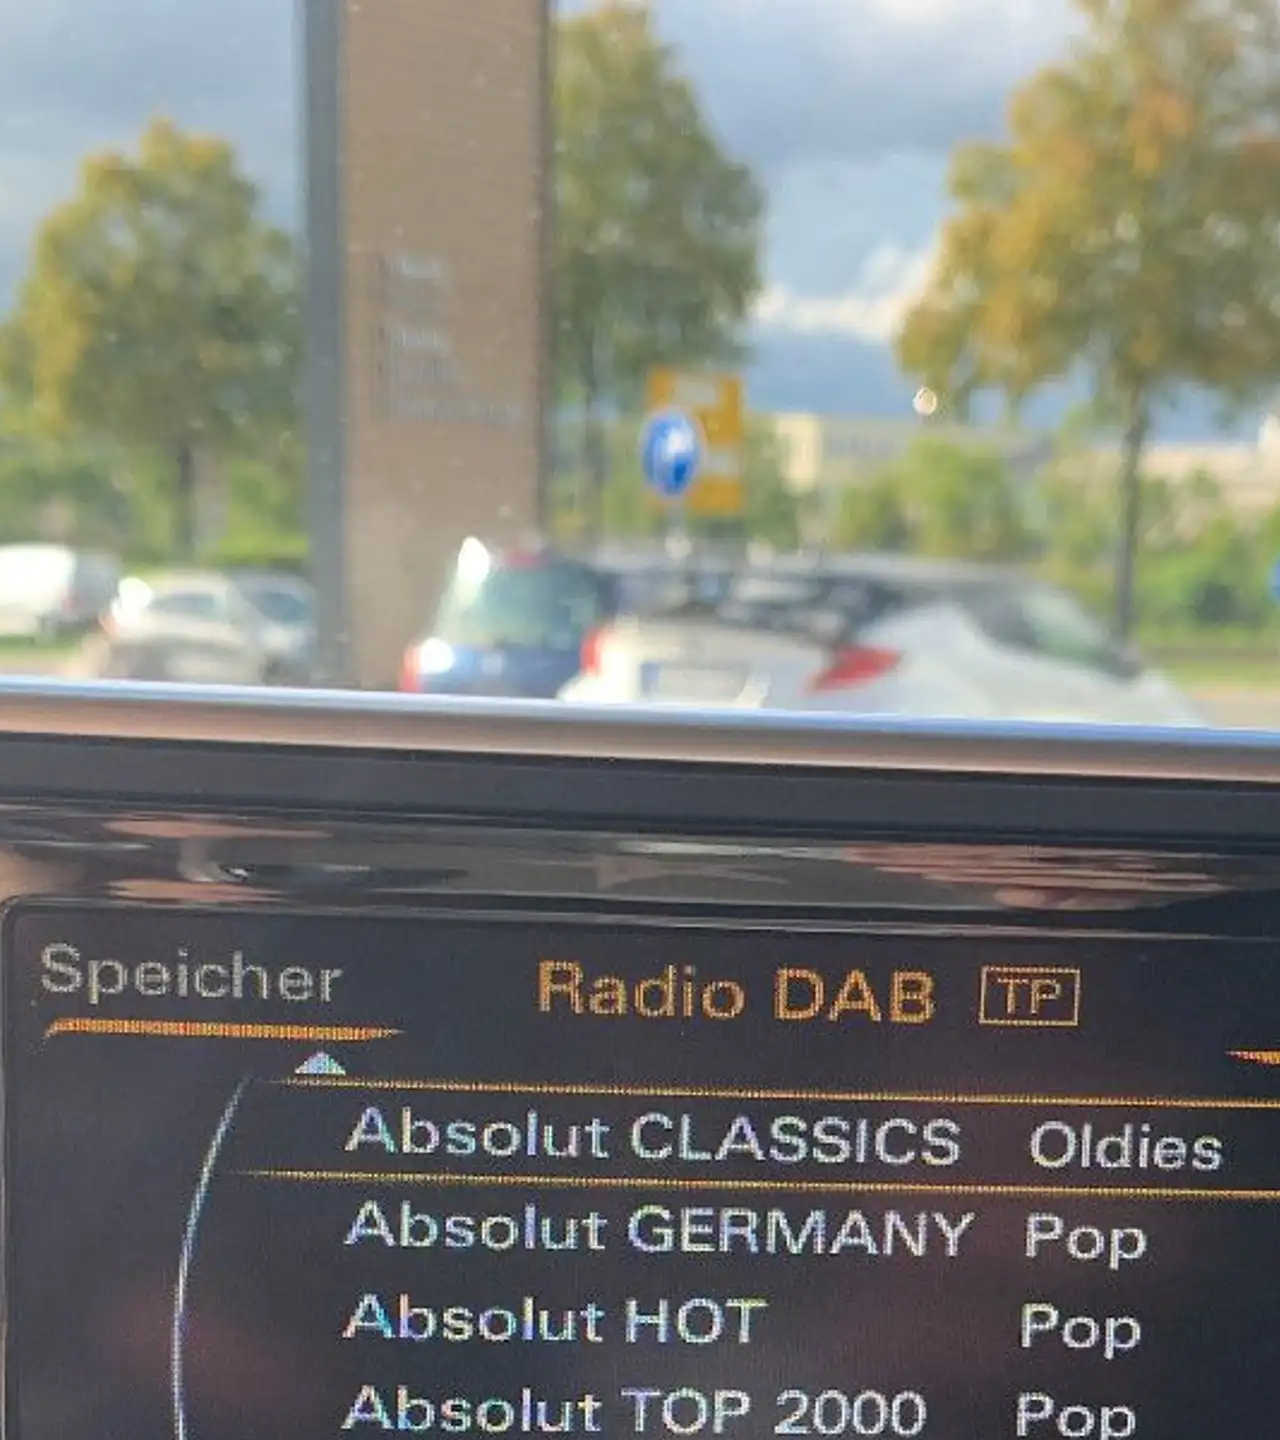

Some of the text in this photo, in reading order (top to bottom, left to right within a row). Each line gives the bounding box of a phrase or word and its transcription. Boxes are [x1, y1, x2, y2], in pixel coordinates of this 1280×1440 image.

[40, 942, 344, 1004] Speicher
[539, 961, 935, 1024] Radio DAB
[996, 976, 1062, 1015] TP
[345, 1105, 961, 1165] Absolut CLASSICS
[1030, 1120, 1224, 1171] Oldies
[343, 1199, 974, 1257] Absolut GERMANY
[1025, 1212, 1148, 1270] Pop
[342, 1292, 768, 1344] Absolut HOT
[1020, 1303, 1141, 1360] Pop
[341, 1385, 927, 1437] Absolut TOP 2000
